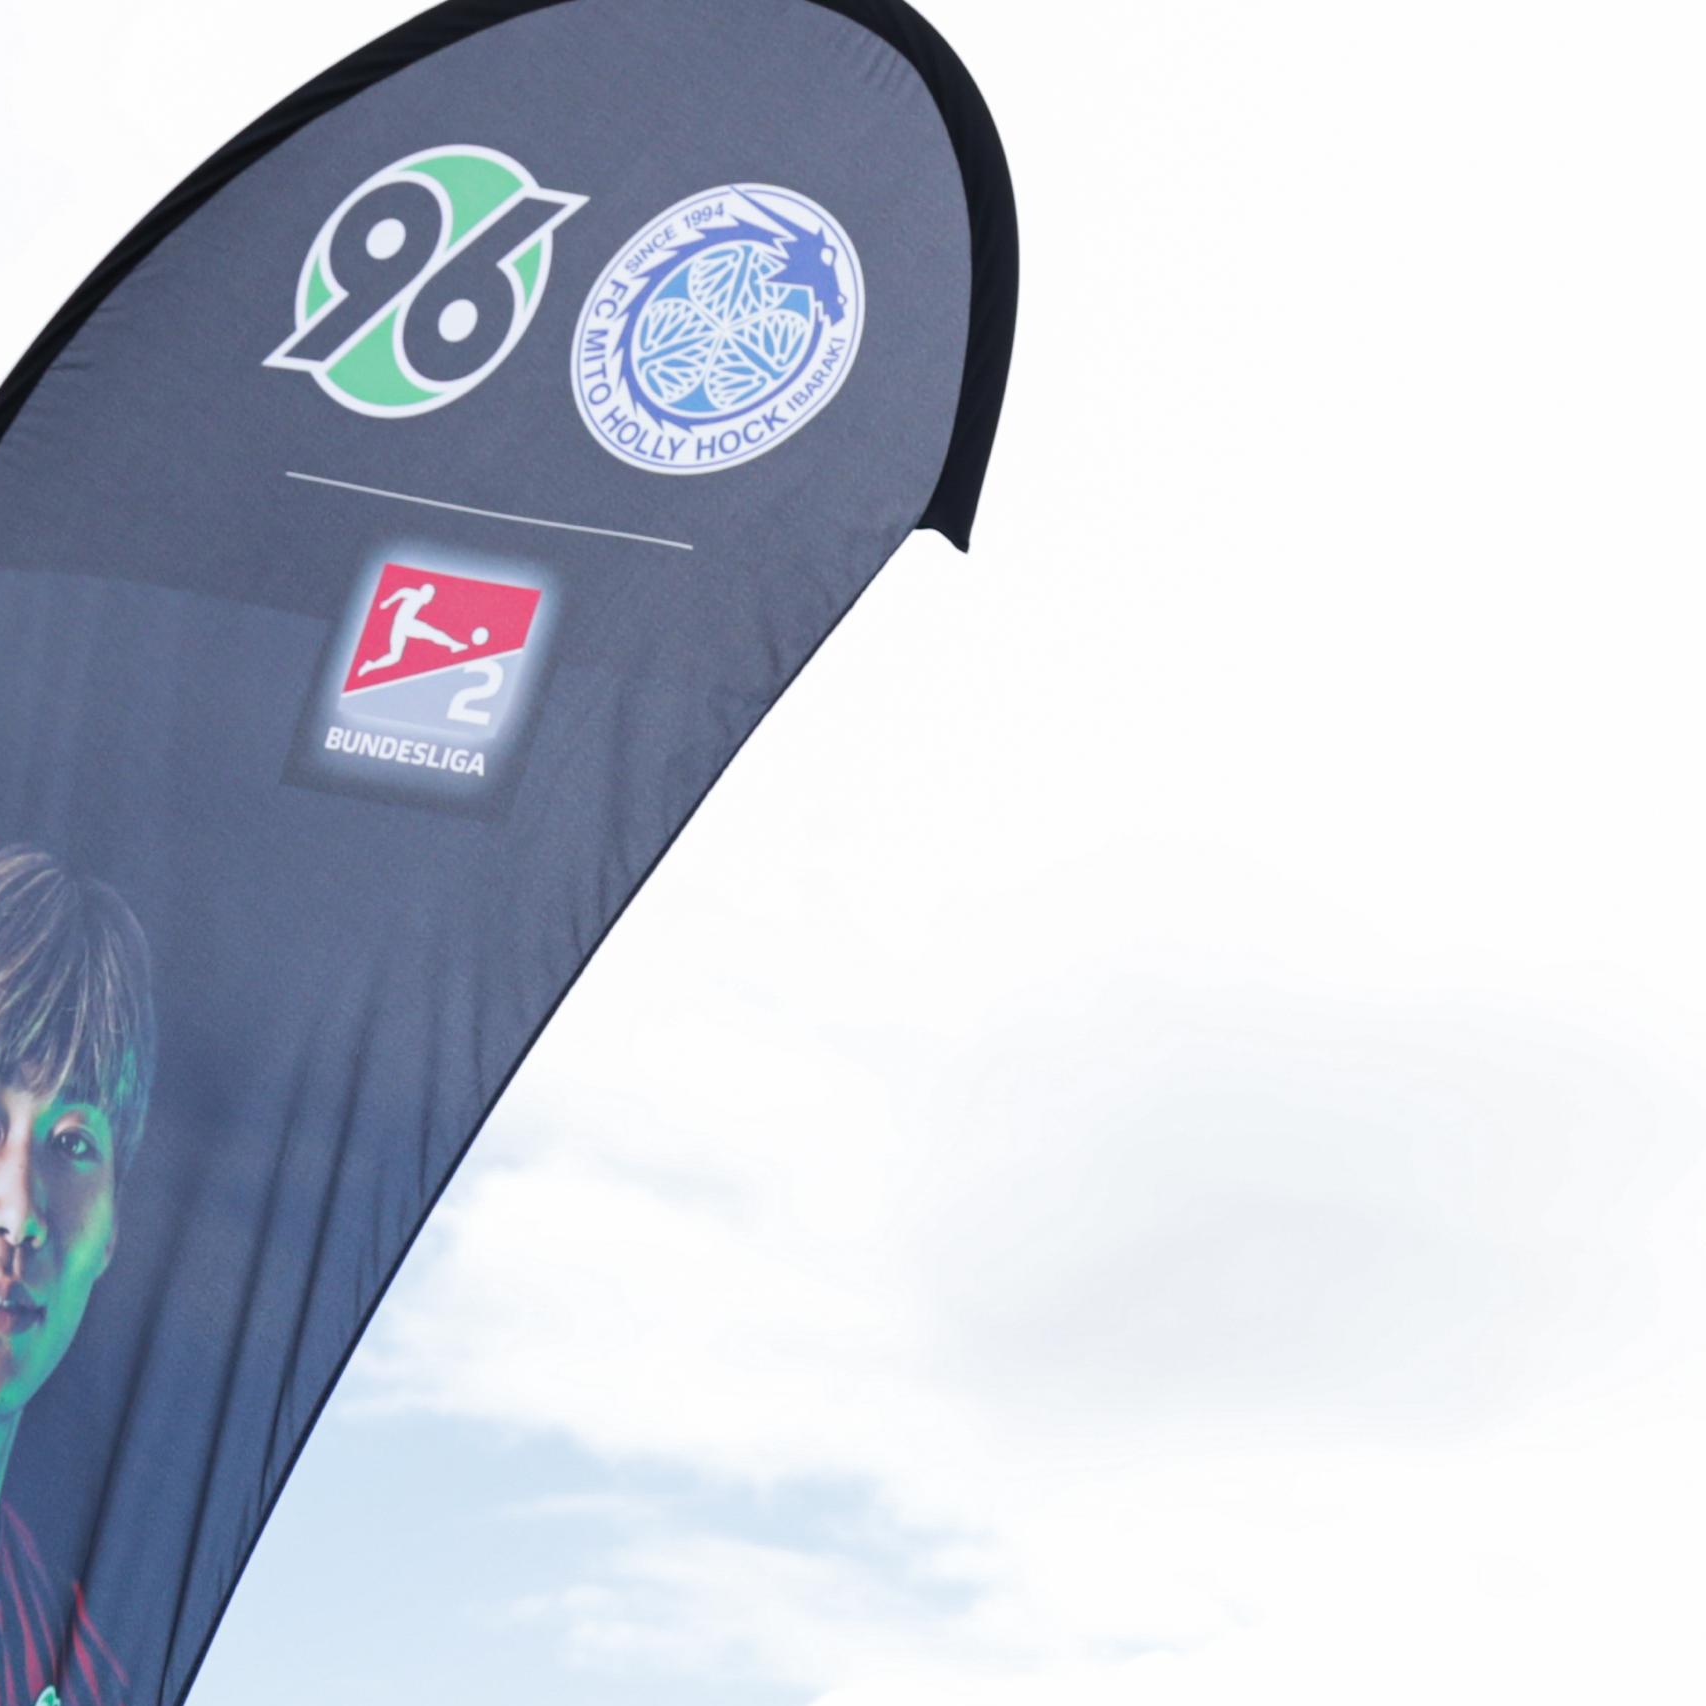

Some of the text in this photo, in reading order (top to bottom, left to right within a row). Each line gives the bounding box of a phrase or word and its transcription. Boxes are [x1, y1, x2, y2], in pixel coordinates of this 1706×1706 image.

[624, 202, 726, 274] SINCE 1994
[262, 168, 590, 396] 96
[583, 279, 847, 462] FC MITO HOLLY HOCK IBARAKI
[446, 660, 505, 727] 2
[324, 725, 486, 777] BUNDESLIGA
